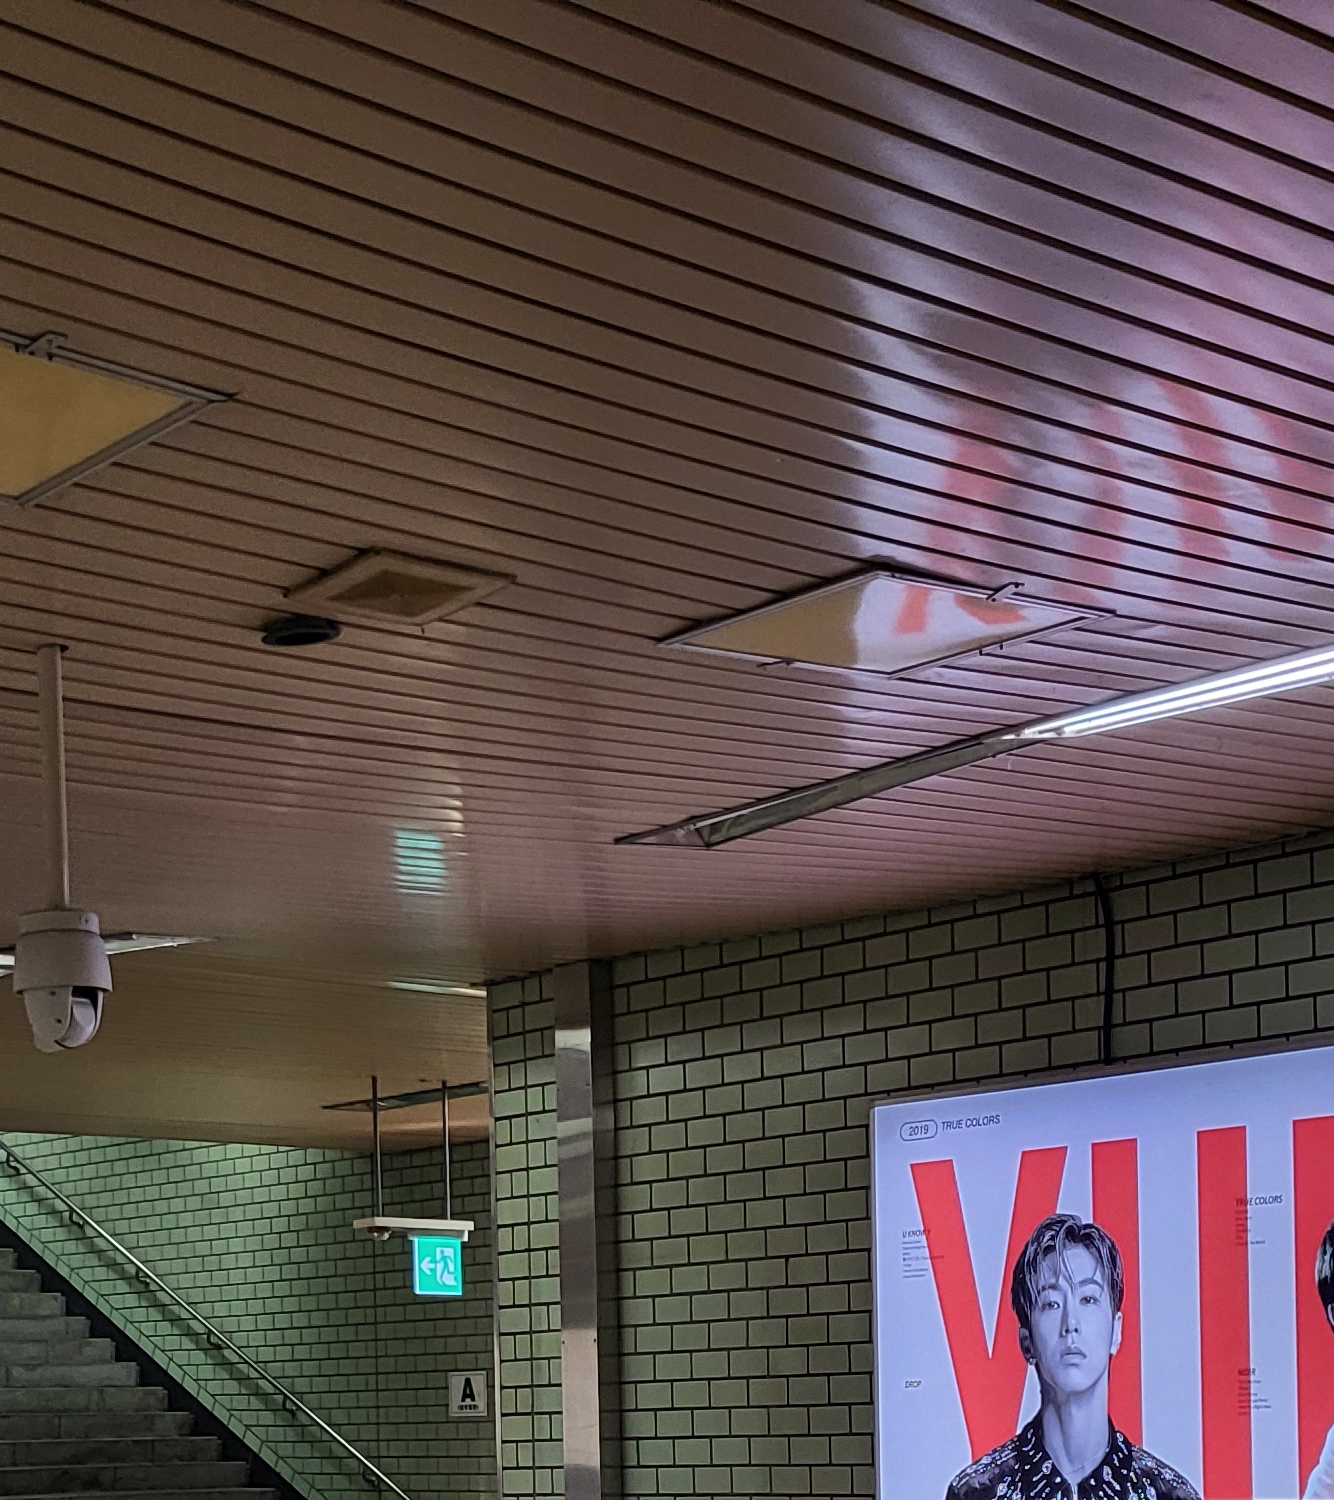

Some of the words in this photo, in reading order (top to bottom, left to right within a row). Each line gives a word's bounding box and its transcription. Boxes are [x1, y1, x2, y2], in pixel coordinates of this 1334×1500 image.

[909, 1125, 929, 1136] 2019
[942, 1119, 964, 1131] TRUE
[965, 1114, 1001, 1128] COLORS
[460, 1377, 476, 1402] A
